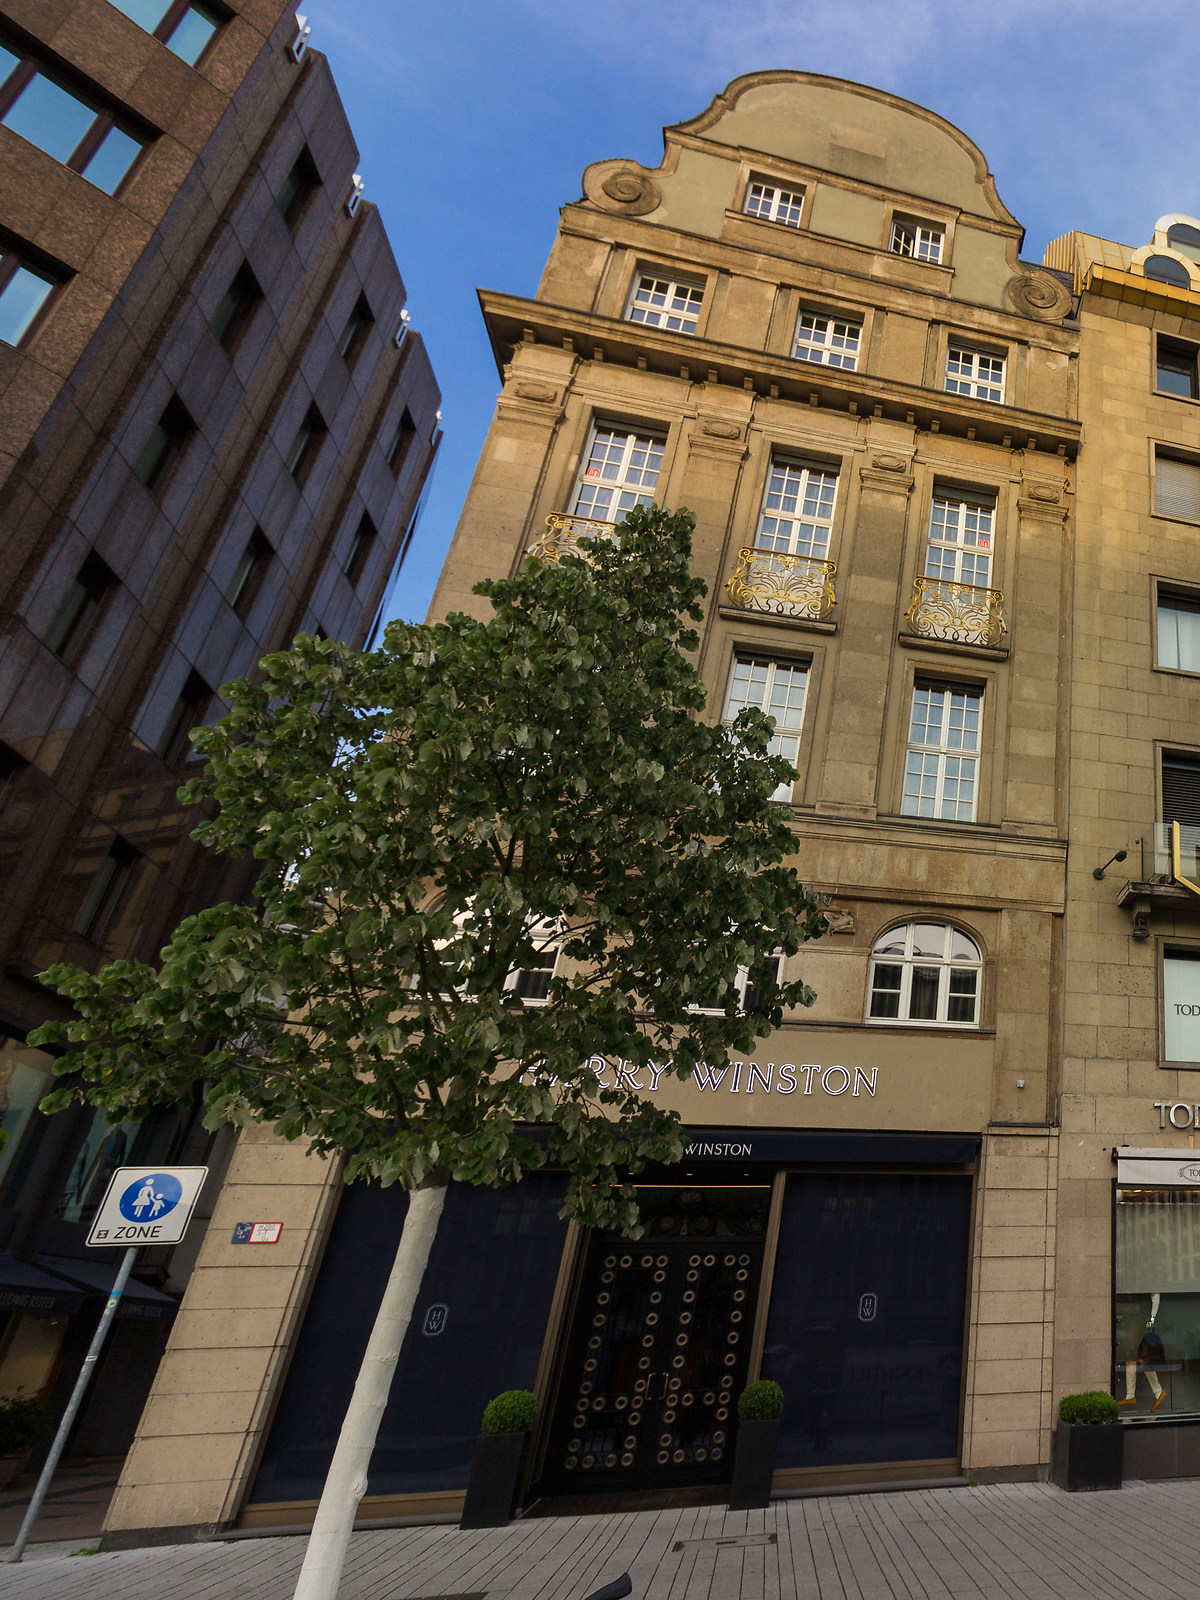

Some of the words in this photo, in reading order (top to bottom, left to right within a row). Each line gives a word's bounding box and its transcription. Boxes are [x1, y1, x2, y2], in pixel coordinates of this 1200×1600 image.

[693, 1061, 879, 1097] WINSTON
[685, 1143, 752, 1156] WINSTON
[114, 1226, 163, 1239] ZONE
